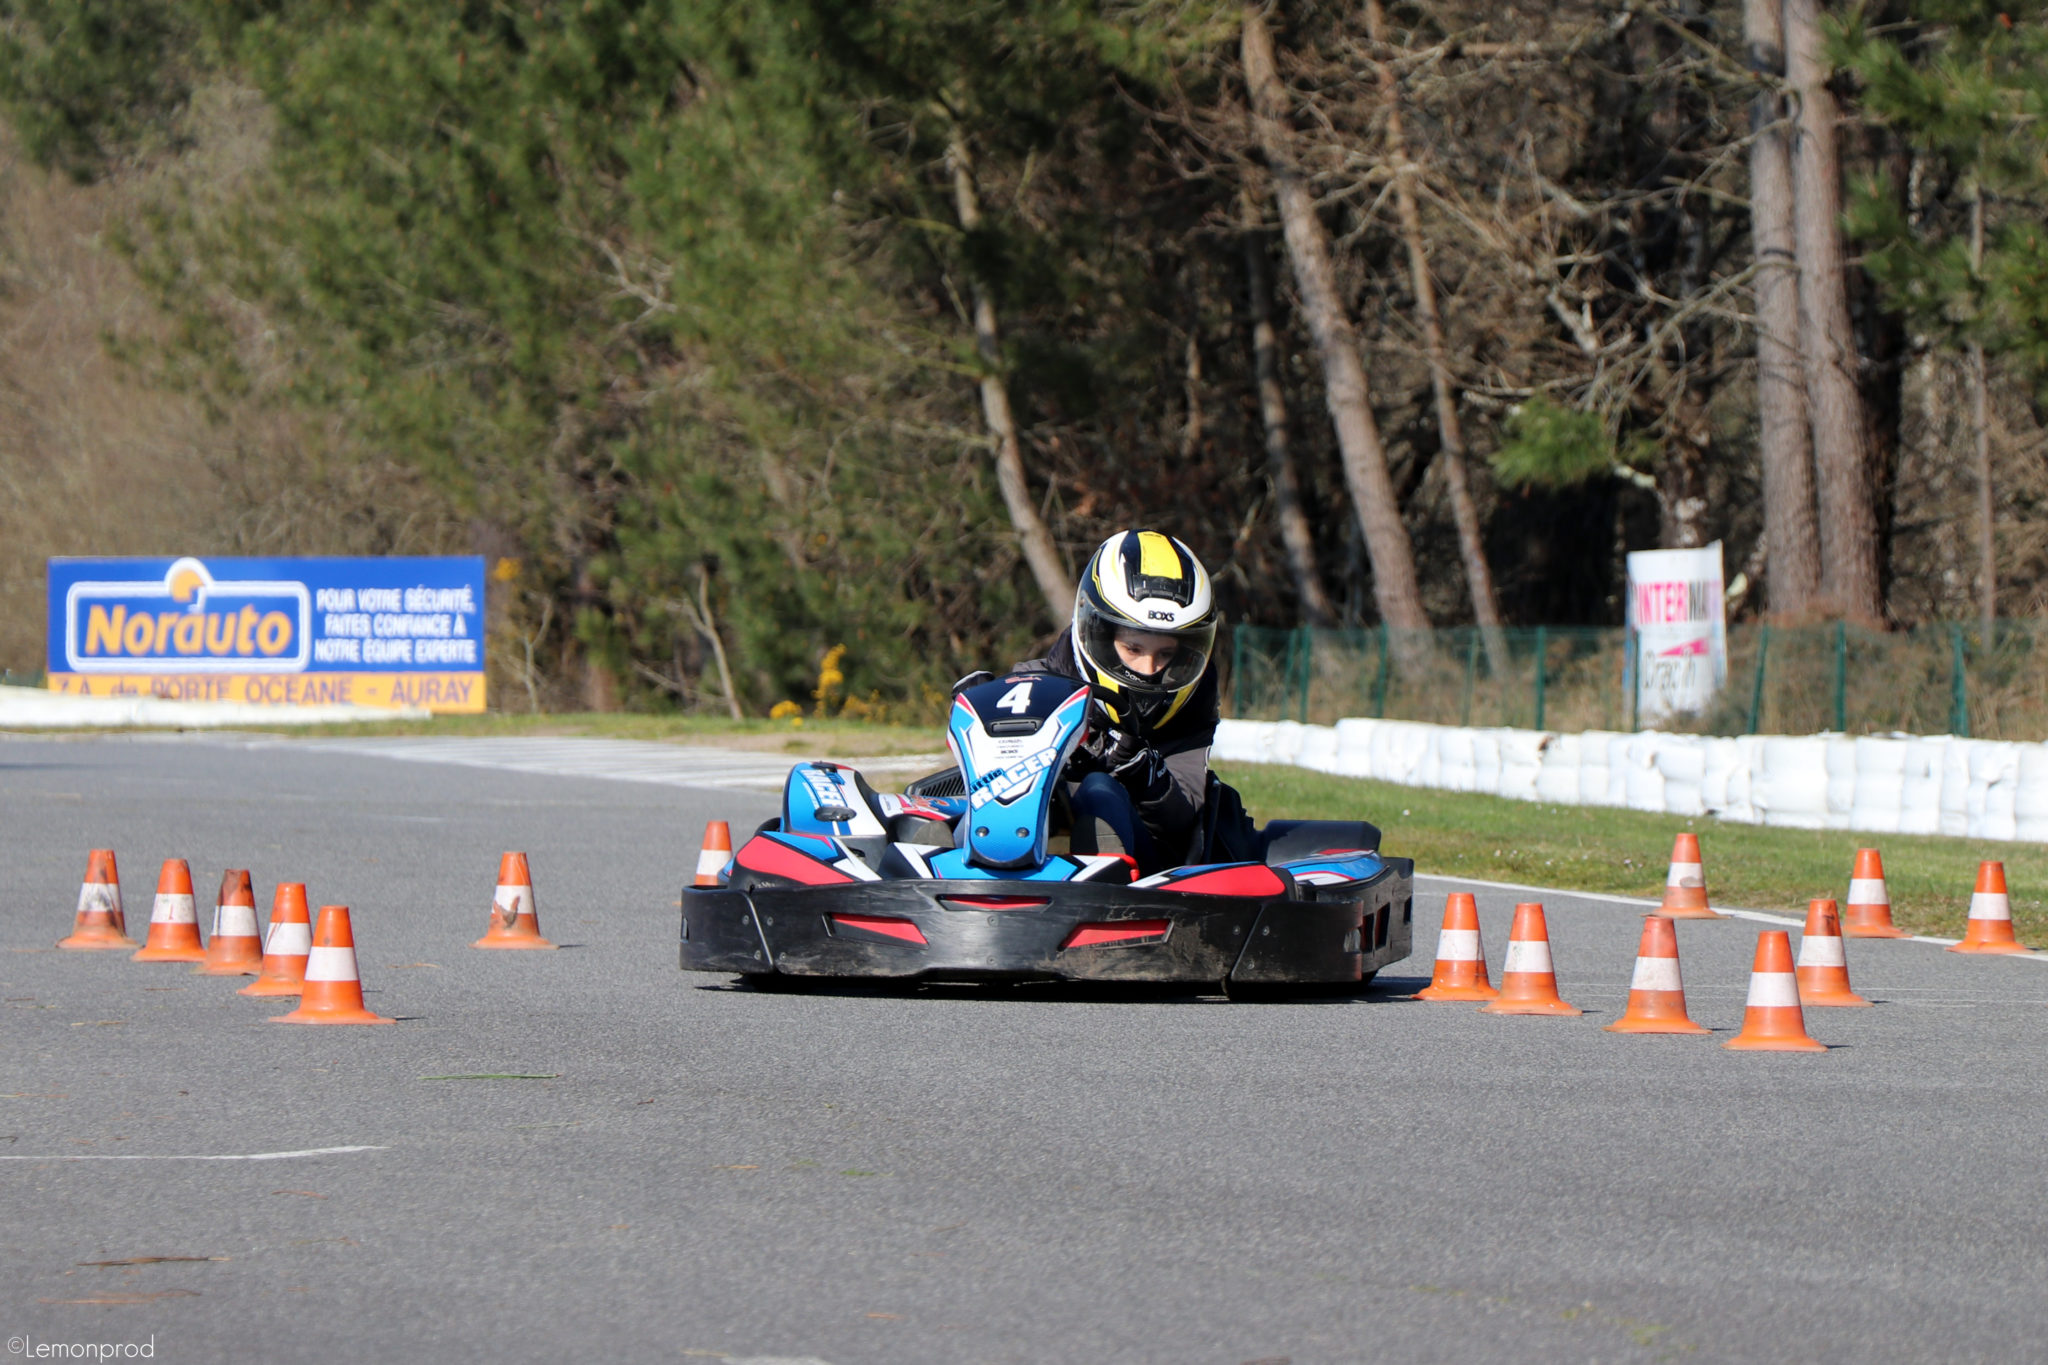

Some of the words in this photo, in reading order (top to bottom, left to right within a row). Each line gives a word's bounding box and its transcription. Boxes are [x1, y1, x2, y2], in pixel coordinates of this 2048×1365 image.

[316, 588, 356, 612] POUR
[357, 588, 402, 612] VOTRE
[85, 604, 292, 655] Norauto
[325, 613, 372, 637] FAITES
[373, 613, 451, 637] CONFIANCE
[1148, 610, 1175, 622] BOXS
[315, 638, 360, 662] NOTRE
[362, 635, 412, 663] ÉQUIPE
[414, 638, 477, 663] EXPERTE
[244, 674, 351, 704] OCEANE
[390, 677, 473, 705] AURAY
[996, 682, 1033, 714] 4
[970, 747, 1057, 809] RACER
